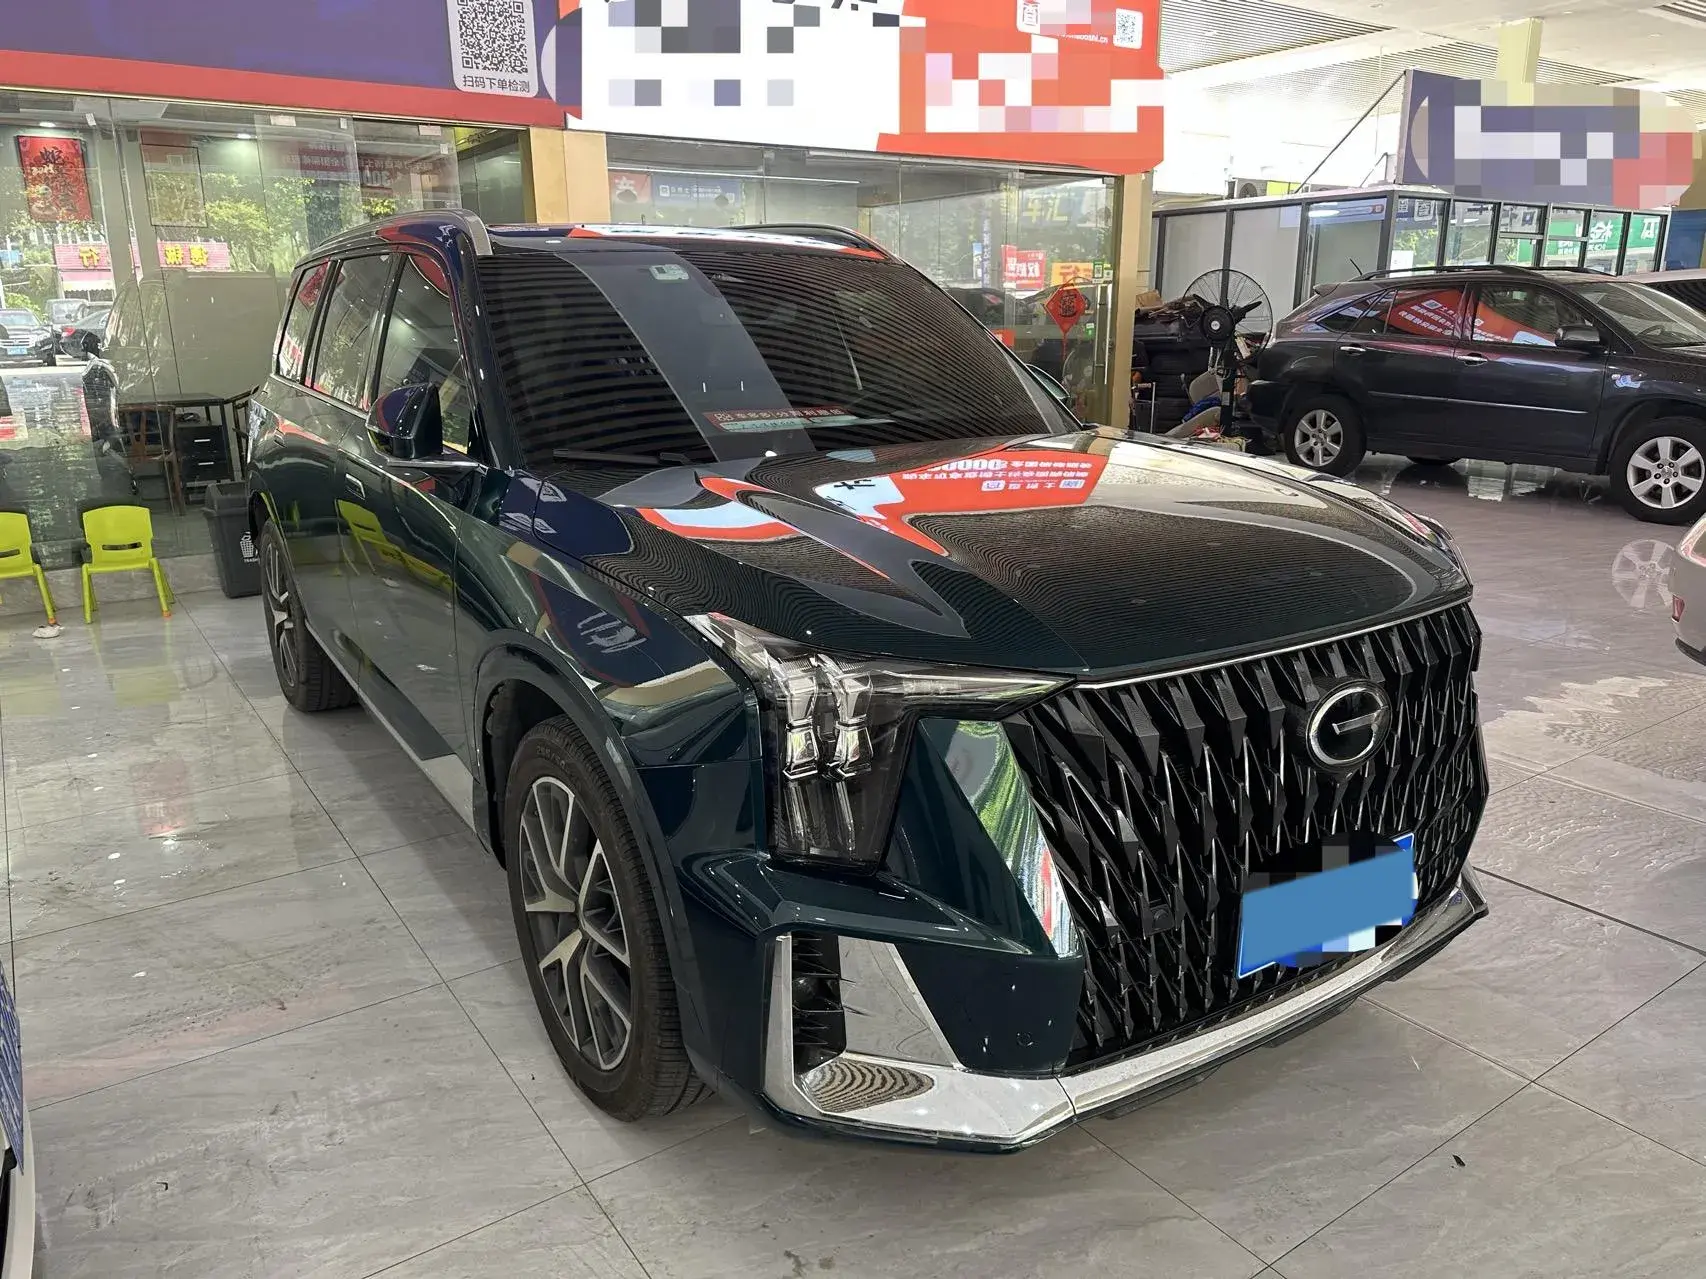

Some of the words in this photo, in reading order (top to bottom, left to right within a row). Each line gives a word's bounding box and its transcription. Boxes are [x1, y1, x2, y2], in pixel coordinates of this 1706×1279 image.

[463, 75, 530, 93] 扫码下单检测
